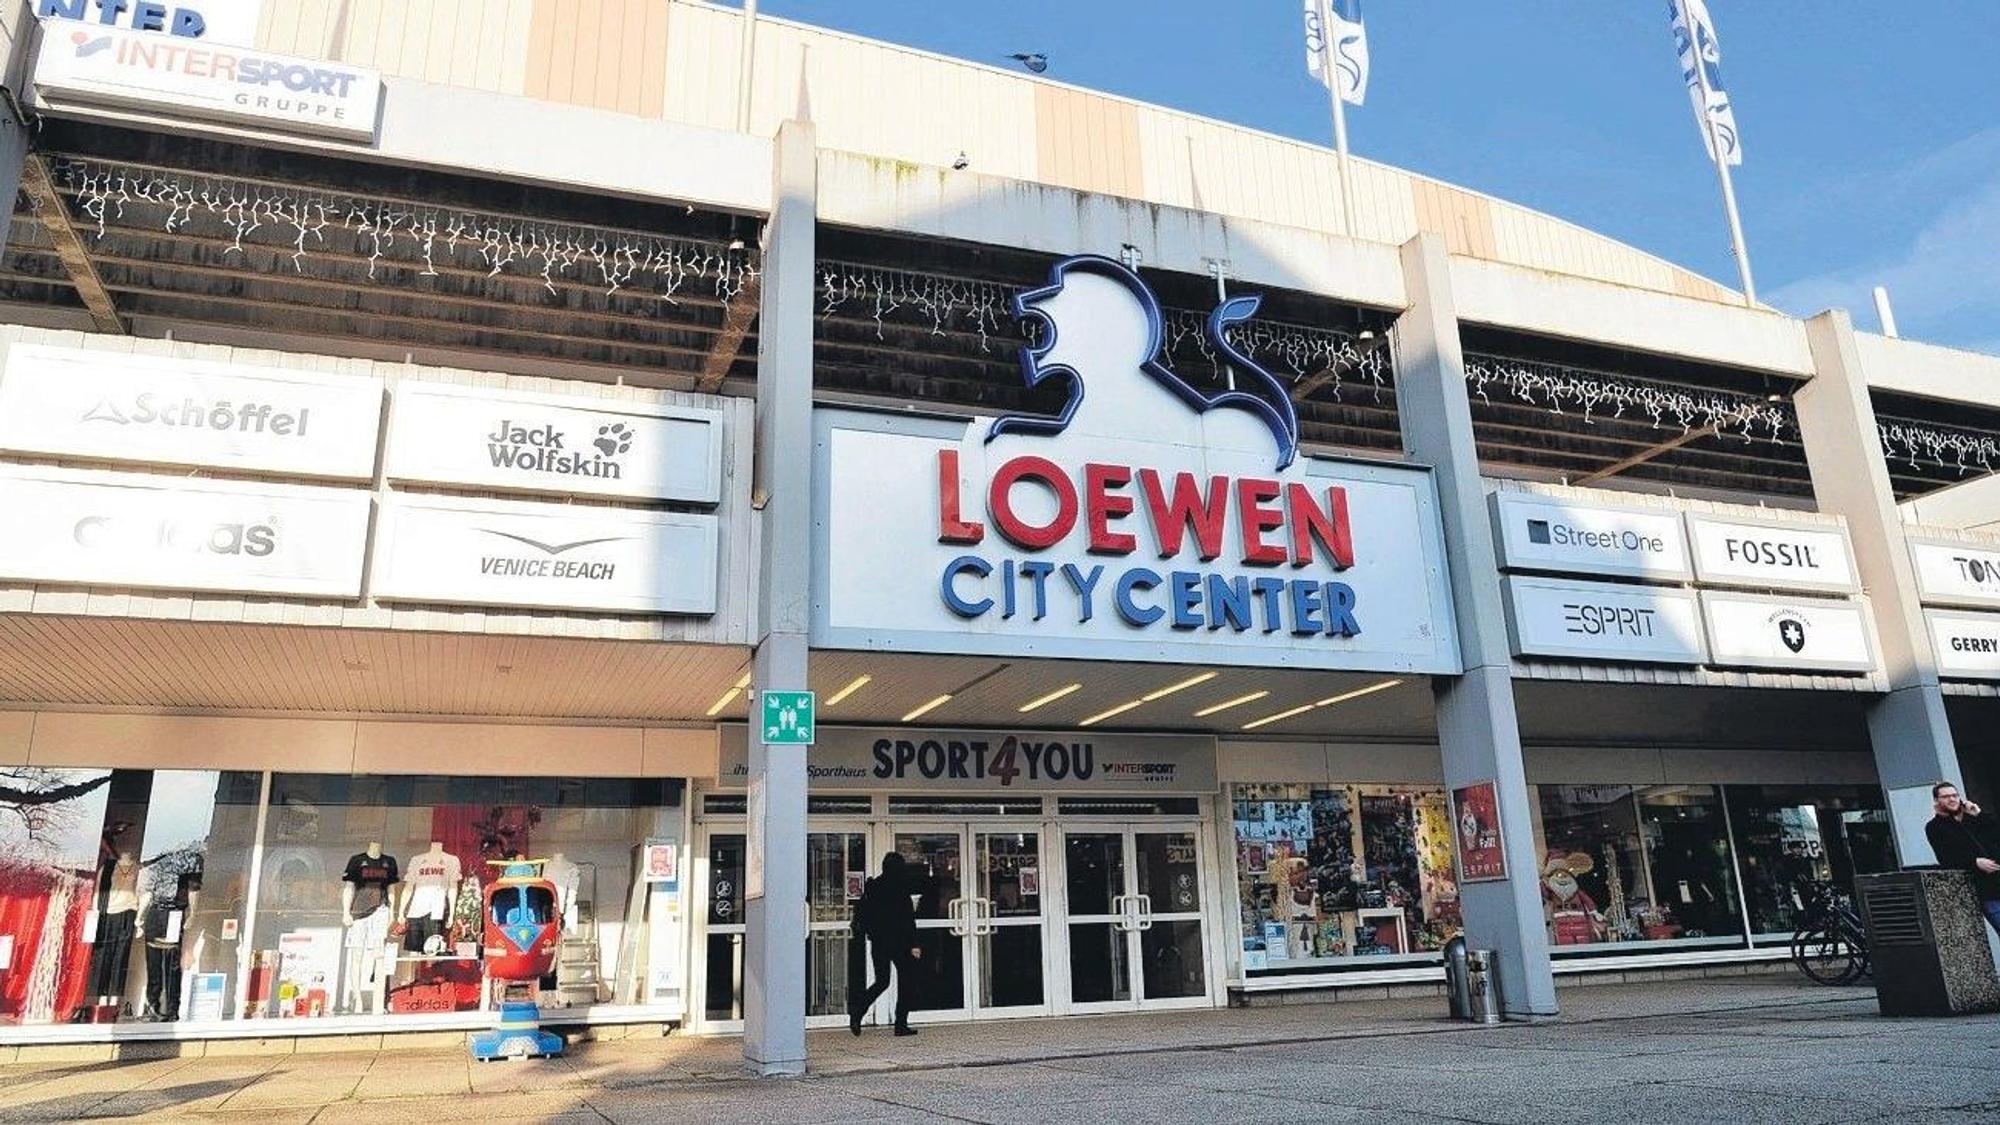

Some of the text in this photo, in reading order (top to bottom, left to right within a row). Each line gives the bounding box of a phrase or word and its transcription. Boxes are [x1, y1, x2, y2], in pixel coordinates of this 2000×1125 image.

[116, 38, 357, 98] INTERSPORT
[234, 93, 345, 119] GRUPPE
[488, 420, 564, 449] Jack
[488, 443, 621, 479] Wolfskin
[937, 449, 1355, 571] LOEWEN
[1553, 524, 1663, 552] Street One
[1725, 538, 1819, 568] FOSSIL
[481, 557, 616, 580] VENICE BEACH
[941, 555, 1362, 637] CITY CENTER
[1563, 604, 1654, 637] ESPRIT
[1951, 637, 1998, 653] GERRY
[807, 765, 867, 778] Sporthaus
[872, 736, 1094, 786] SPORT4YOU
[1113, 763, 1176, 774] INTERSPORT
[418, 867, 446, 877] REWE
[1464, 862, 1502, 876] ESPRIT
